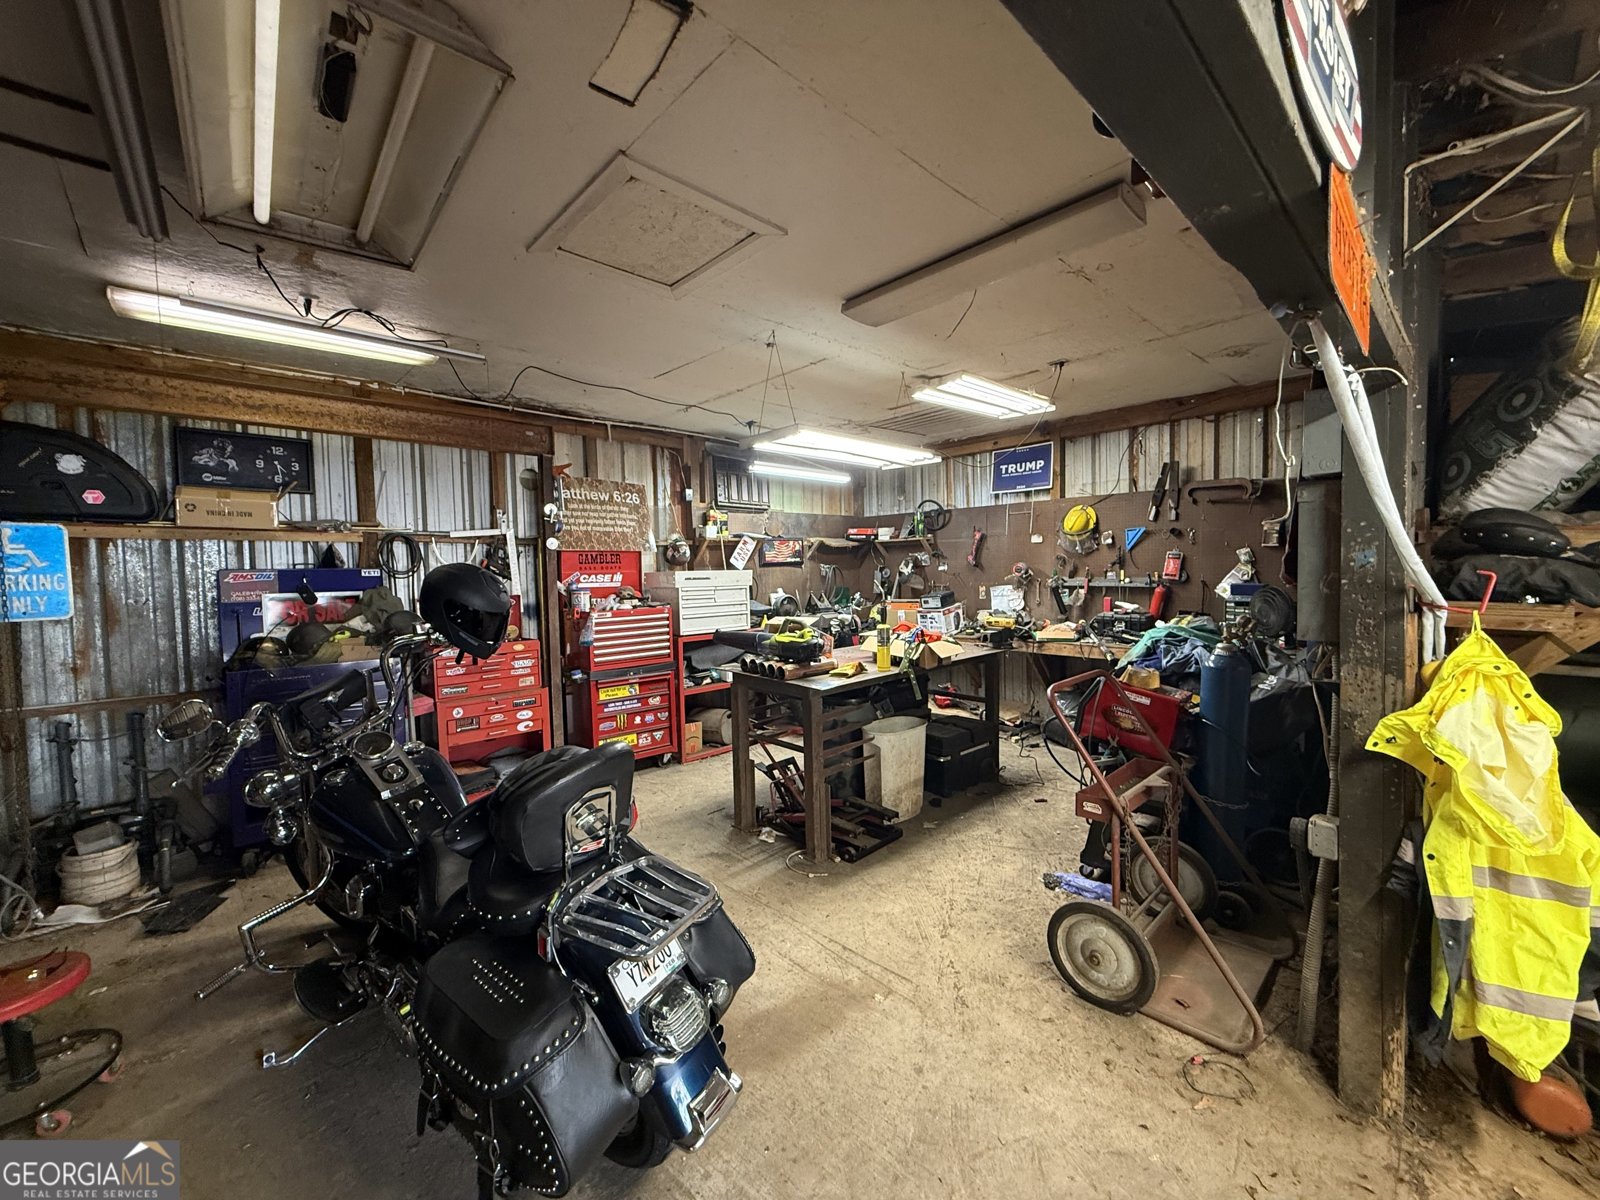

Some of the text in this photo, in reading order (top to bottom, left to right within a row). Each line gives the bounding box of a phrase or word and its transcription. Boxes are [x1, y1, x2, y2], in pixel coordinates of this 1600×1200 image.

[270, 446, 284, 455] 12
[255, 459, 264, 468] 9
[291, 462, 300, 471] 3
[1000, 459, 1045, 474] TRUMP
[274, 475, 283, 483] 6
[562, 487, 640, 504] atthew 6:26
[206, 509, 226, 517] CHINA
[733, 539, 749, 562] FARM
[578, 553, 622, 565] GAMBLER
[0, 573, 65, 592] RKING
[228, 572, 275, 583] AMSOIL
[580, 574, 613, 582] CASE
